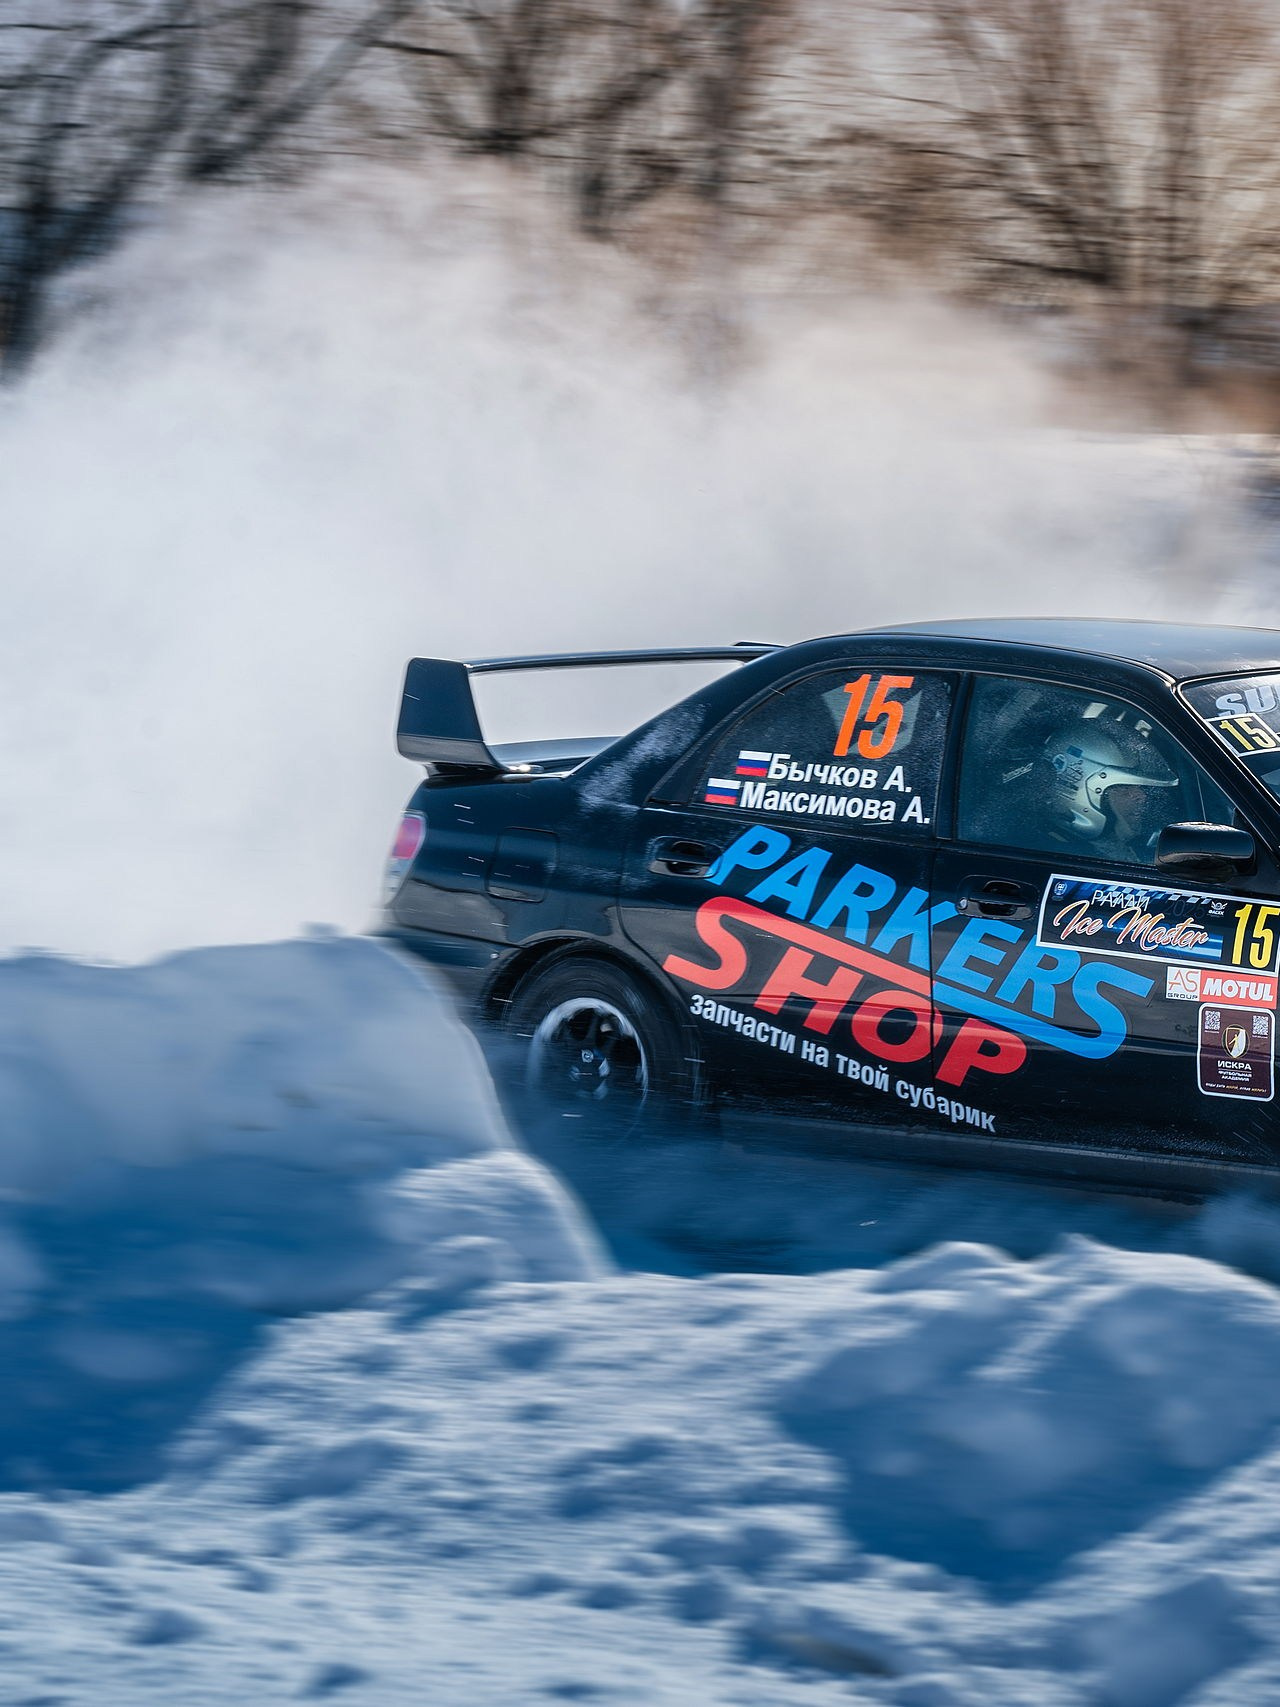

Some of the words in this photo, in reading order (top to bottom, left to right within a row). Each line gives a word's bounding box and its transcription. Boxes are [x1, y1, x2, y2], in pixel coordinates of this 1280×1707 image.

[834, 674, 913, 759] 15
[1219, 717, 1277, 751] 15
[767, 754, 878, 789] Бычков
[883, 766, 912, 793] А.
[739, 782, 894, 821] Максимова
[901, 796, 931, 824] А.
[705, 825, 1155, 1059] PARKERS
[1053, 900, 1103, 940] Ice
[1107, 906, 1210, 951] Master
[1232, 904, 1280, 968] 15
[663, 896, 1027, 1086] SHOP
[1167, 992, 1199, 1000] GROUP
[1202, 977, 1274, 1002] MOTUL
[689, 994, 796, 1054] запчасти
[801, 1040, 829, 1068] на
[836, 1053, 890, 1092] твой
[896, 1080, 997, 1132] субарик
[1217, 1060, 1252, 1071] ИСКРА
